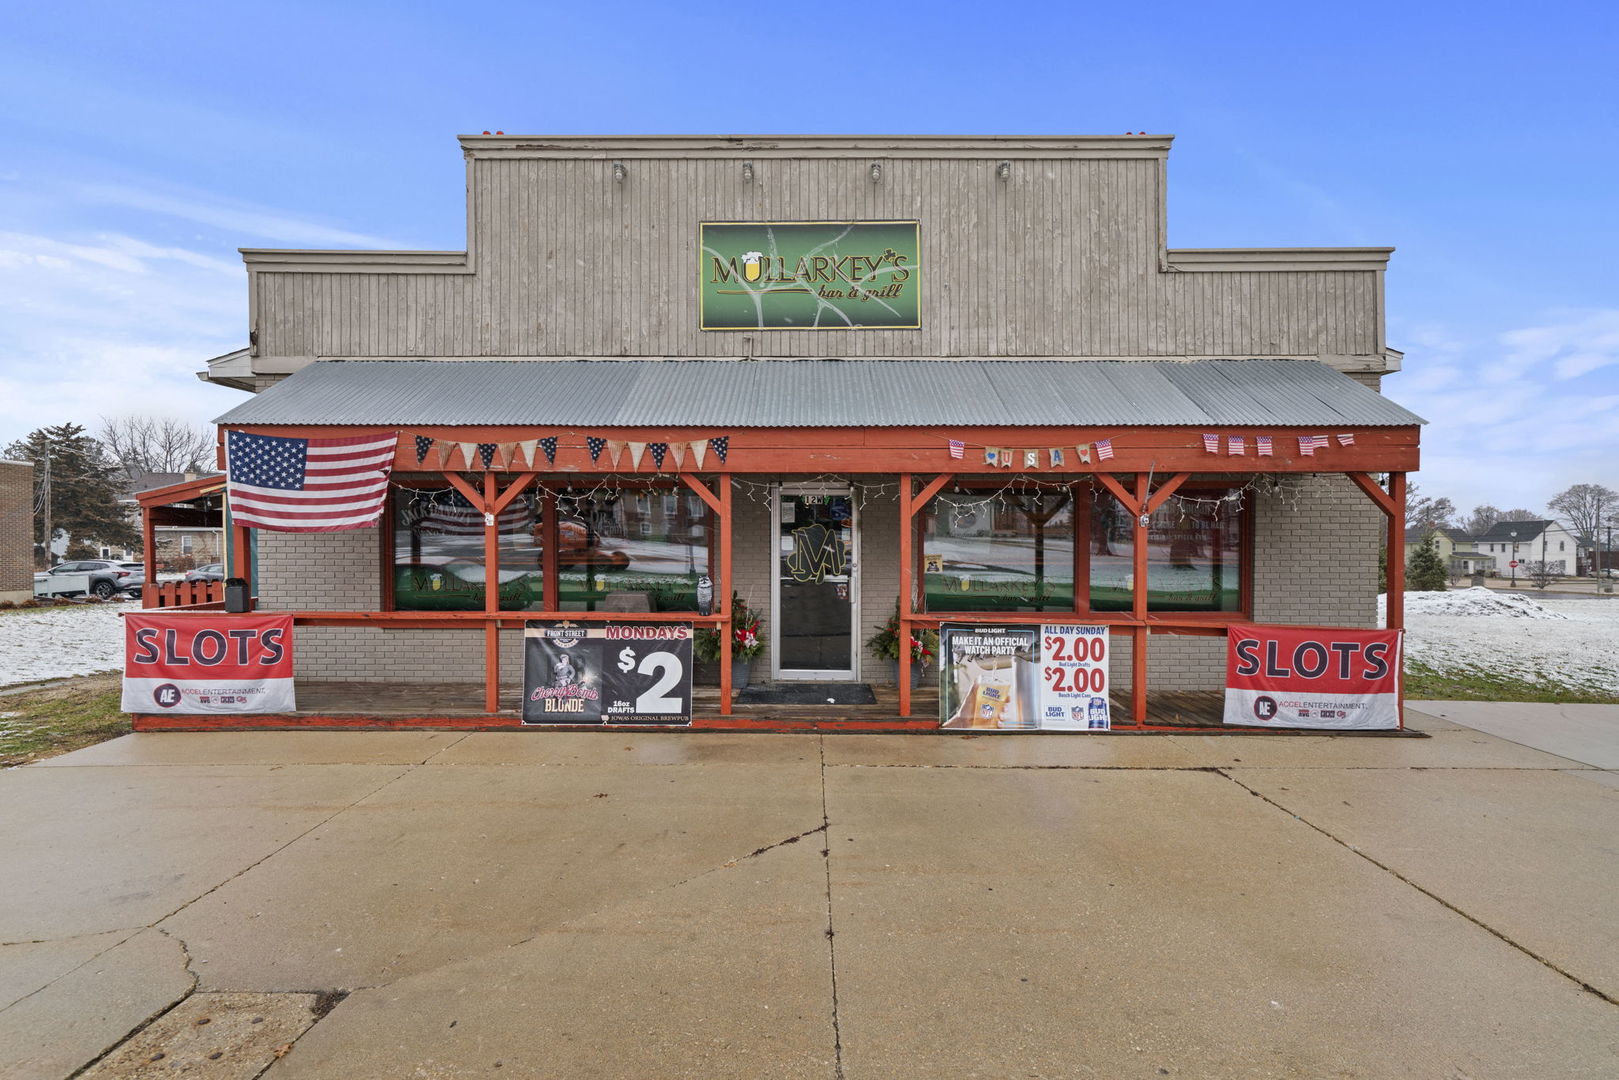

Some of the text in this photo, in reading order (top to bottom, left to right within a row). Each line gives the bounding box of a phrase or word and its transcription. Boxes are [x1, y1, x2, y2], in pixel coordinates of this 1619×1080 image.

[710, 250, 910, 284] MULLARKEY'S
[816, 283, 903, 301] bar & grill
[605, 626, 688, 640] MONDAYS
[1044, 626, 1106, 635] ALL DAY SUNDAY
[133, 628, 284, 667] SLOTS
[952, 637, 1028, 646] MAKE IT AN OFFICIAL
[1044, 635, 1105, 662] $2.00
[965, 646, 1016, 656] WATCH PARTY
[1236, 639, 1389, 680] SLOTS
[1044, 666, 1105, 693] $2.00
[531, 684, 599, 701] Cherry Bomb
[544, 698, 585, 712] BLONDE
[608, 706, 635, 714] DRAFTS
